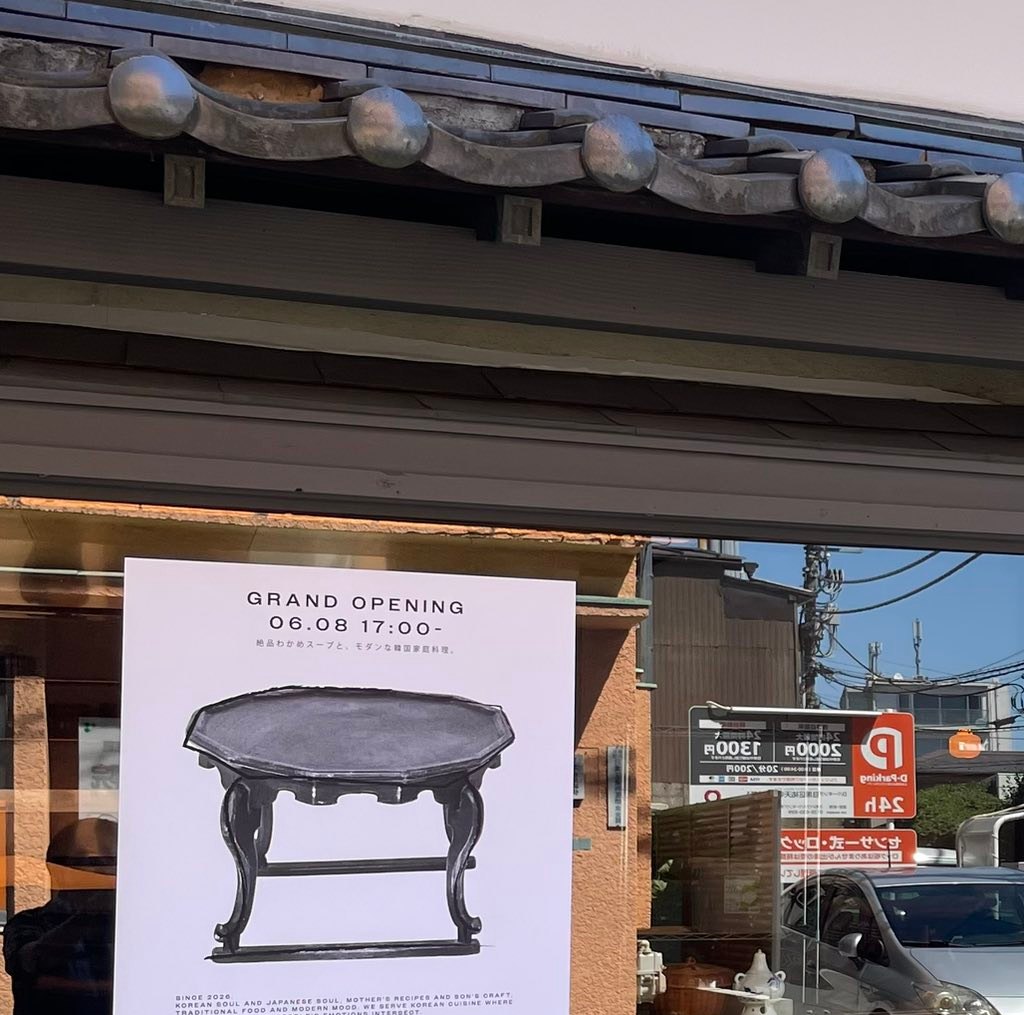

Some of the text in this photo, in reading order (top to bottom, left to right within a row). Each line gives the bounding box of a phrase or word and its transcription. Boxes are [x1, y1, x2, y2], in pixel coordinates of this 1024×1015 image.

[247, 591, 464, 615] GRAND OPENING
[269, 616, 348, 632] 06.08
